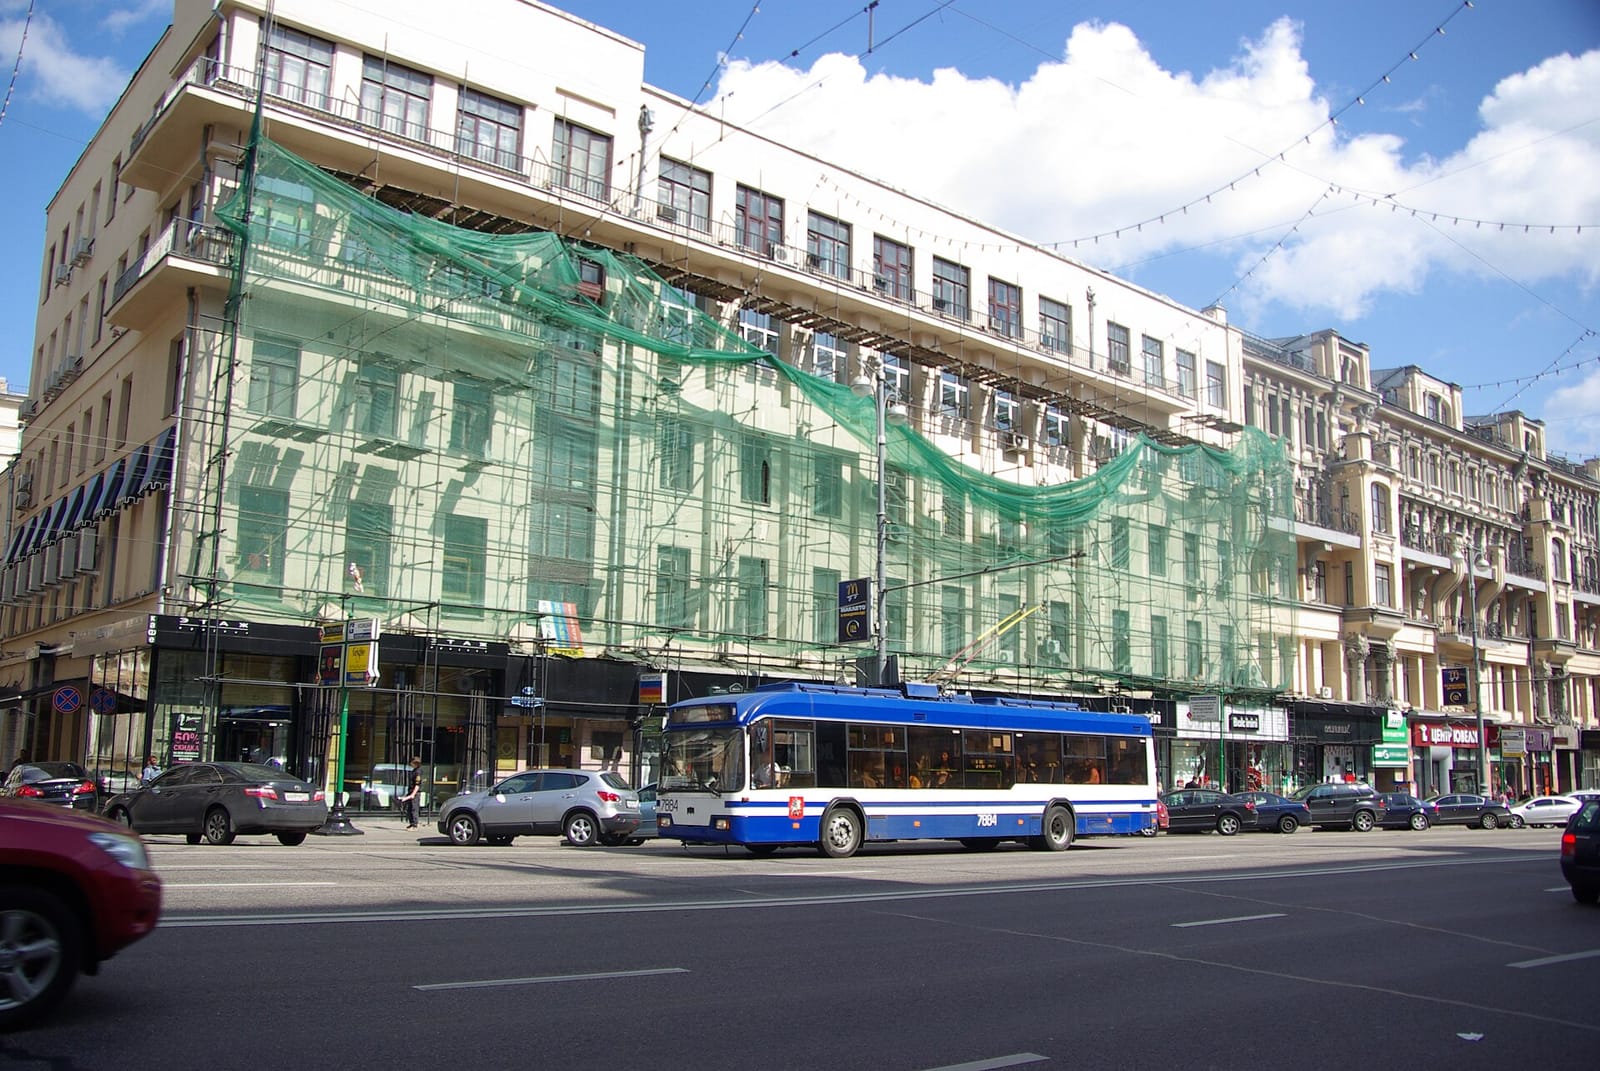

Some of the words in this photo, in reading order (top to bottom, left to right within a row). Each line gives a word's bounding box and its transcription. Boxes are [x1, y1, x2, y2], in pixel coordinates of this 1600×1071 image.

[179, 617, 249, 629] ЭТАЖ
[174, 732, 200, 745] 50%
[1431, 728, 1452, 744] ЦЕНТР
[173, 744, 199, 752] СКИДКА
[661, 799, 679, 812] 7884
[977, 813, 998, 827] 7884
